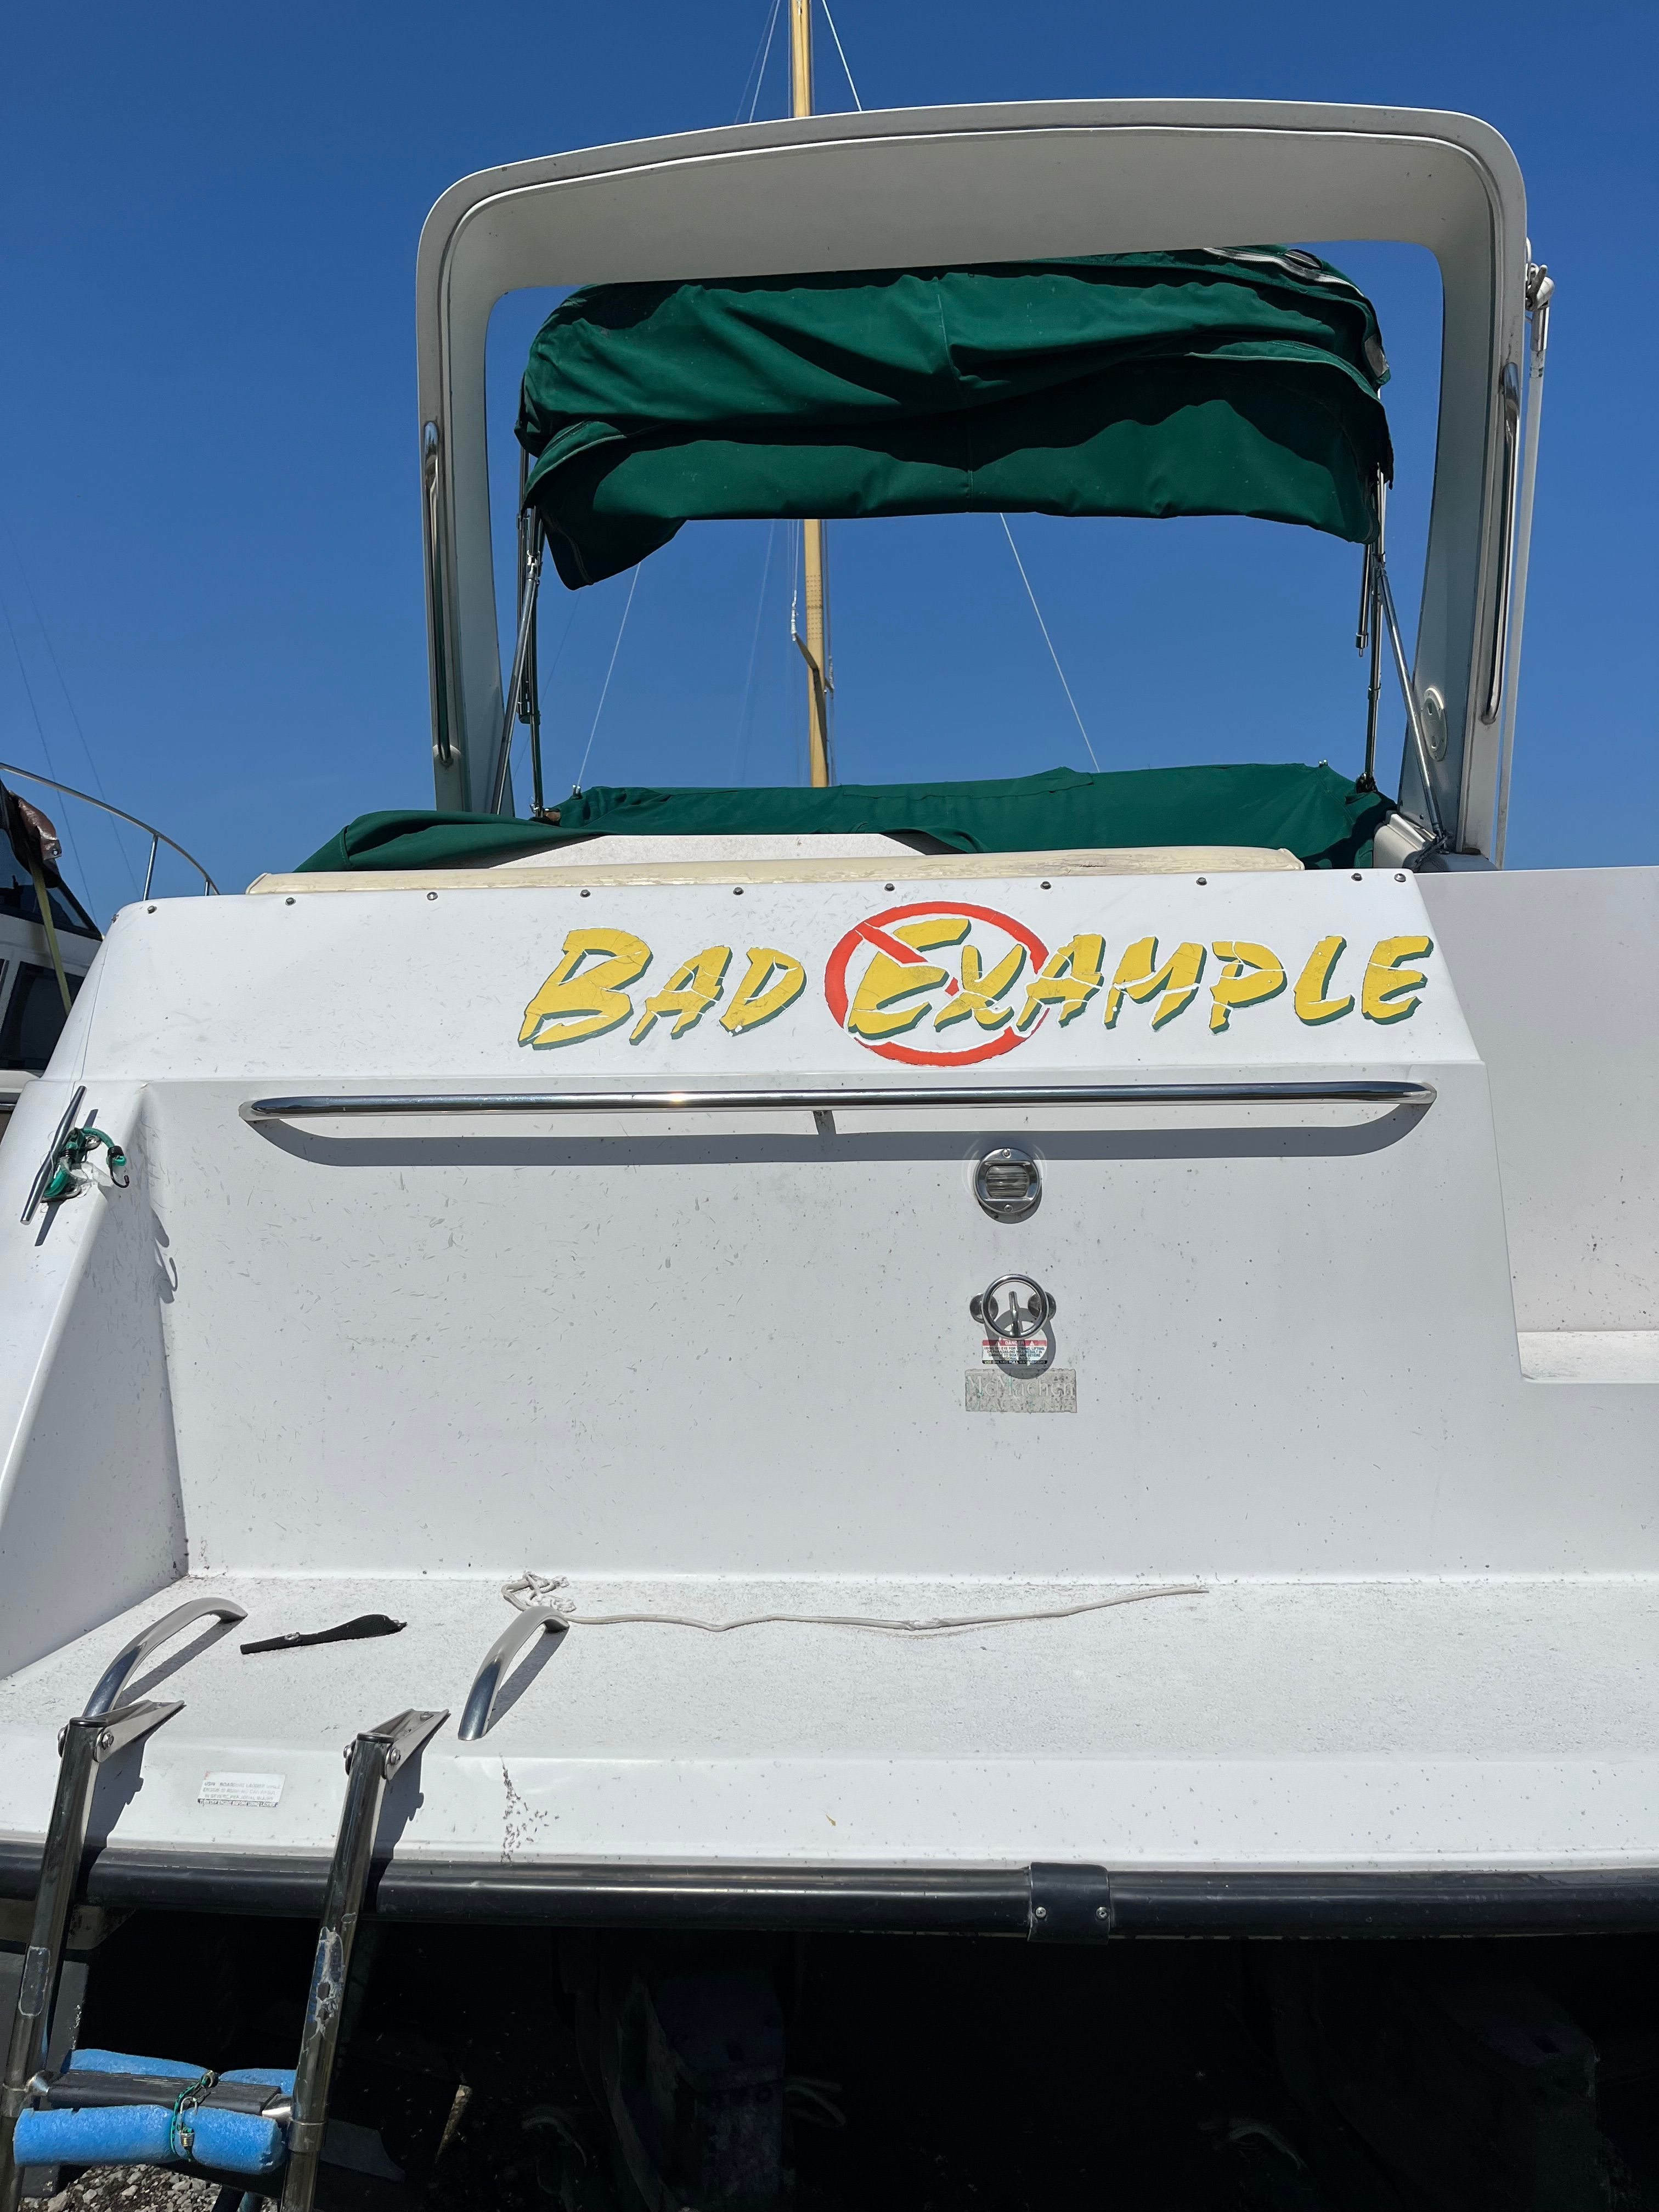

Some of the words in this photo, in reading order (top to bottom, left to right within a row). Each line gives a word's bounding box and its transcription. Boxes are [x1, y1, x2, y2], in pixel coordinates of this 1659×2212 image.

[519, 928, 808, 1048] BAD
[847, 918, 1434, 1039] EXAMPLE
[967, 1375, 1074, 1396] McMachen
